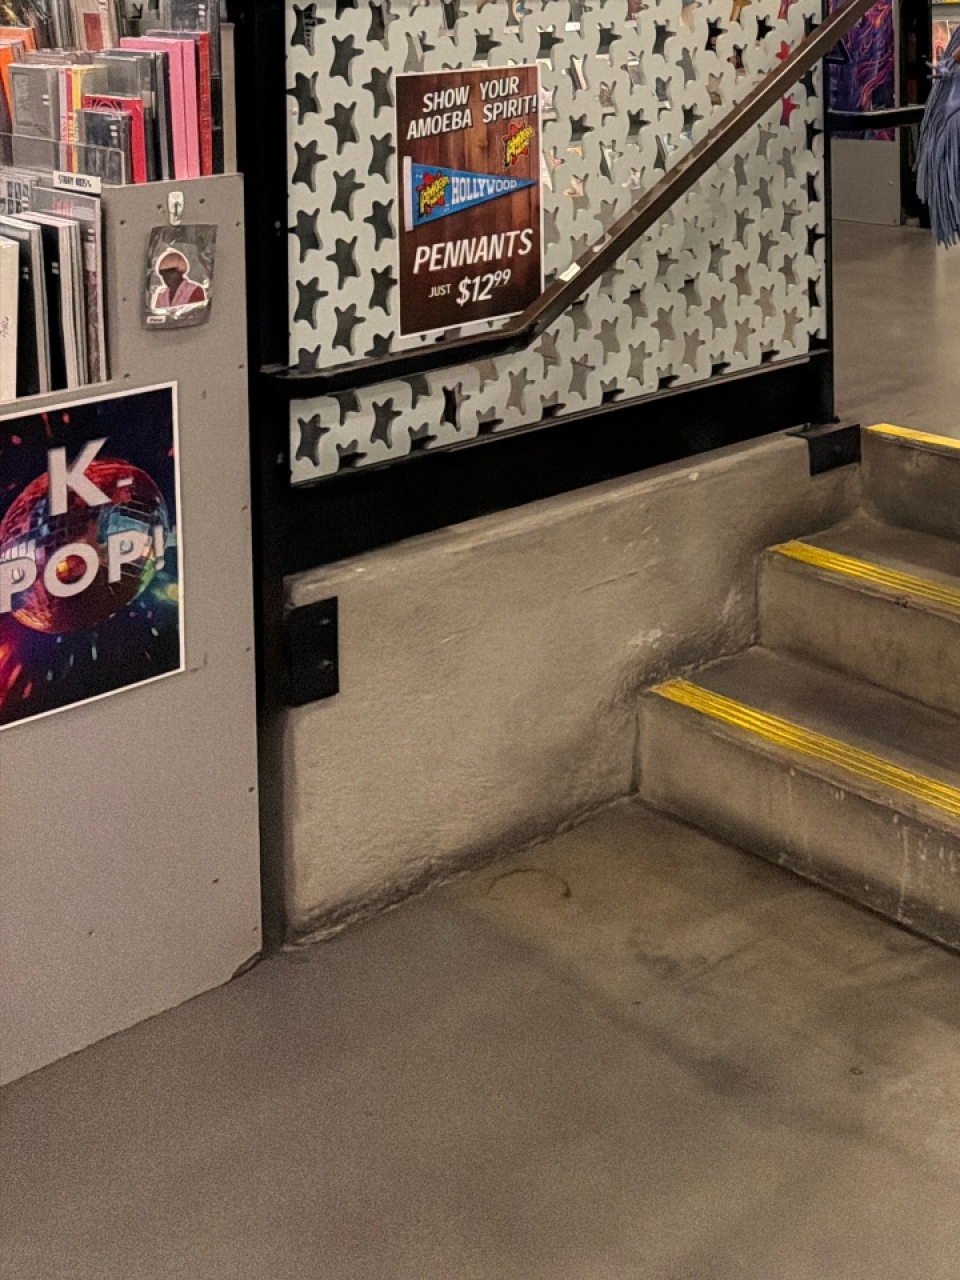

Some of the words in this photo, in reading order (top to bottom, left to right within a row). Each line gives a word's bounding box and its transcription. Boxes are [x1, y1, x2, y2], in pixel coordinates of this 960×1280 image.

[422, 86, 470, 113] SHOW
[480, 76, 519, 100] YOUR
[406, 109, 473, 140] AMOEBA
[483, 95, 538, 124] SPIRIT!
[451, 176, 517, 205] HOLLYWOOD
[413, 229, 533, 274] PENNANTS
[428, 283, 452, 298] JUST
[48, 437, 134, 517] K-
